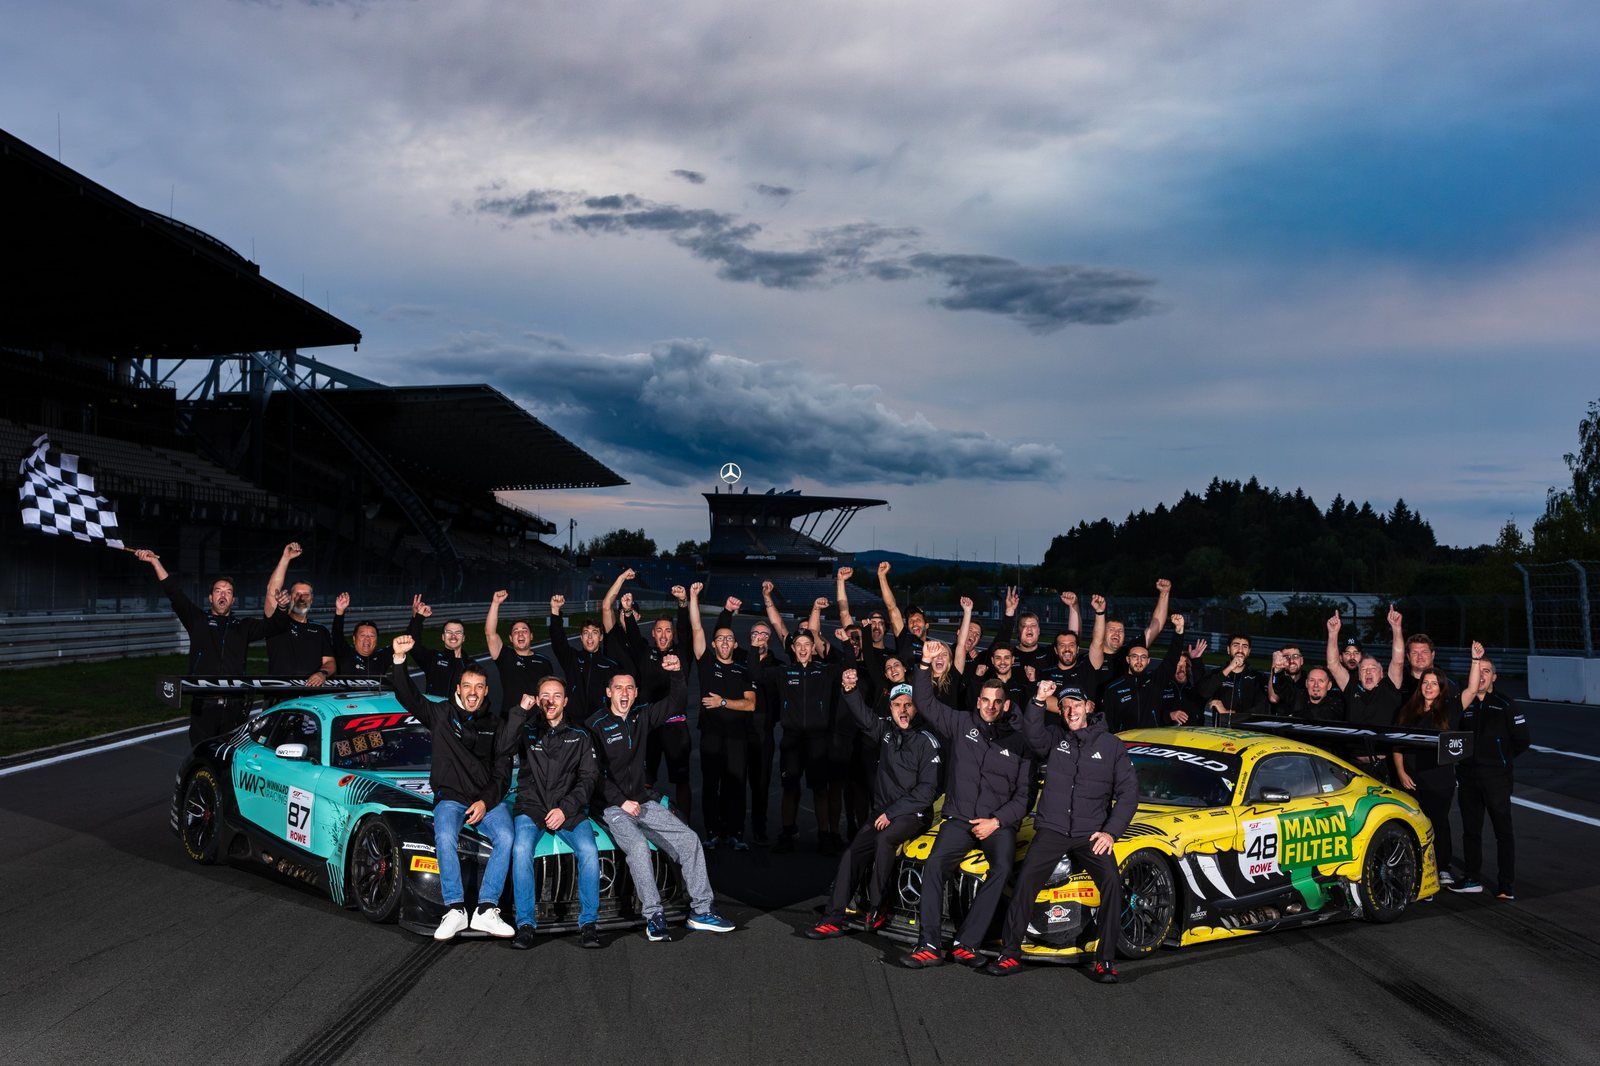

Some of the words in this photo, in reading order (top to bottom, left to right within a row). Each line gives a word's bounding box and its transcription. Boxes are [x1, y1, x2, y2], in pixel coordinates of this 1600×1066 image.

[1448, 738, 1463, 750] aws
[1127, 746, 1228, 772] WORLD
[287, 801, 311, 830] 87
[1284, 811, 1347, 841] MANN
[289, 830, 307, 844] ROWE
[1246, 832, 1278, 861] 48
[1285, 835, 1349, 865] FILTER
[414, 858, 438, 871] PIRE
[1249, 862, 1273, 875] ROWE
[1053, 887, 1094, 899] PIRELLI
